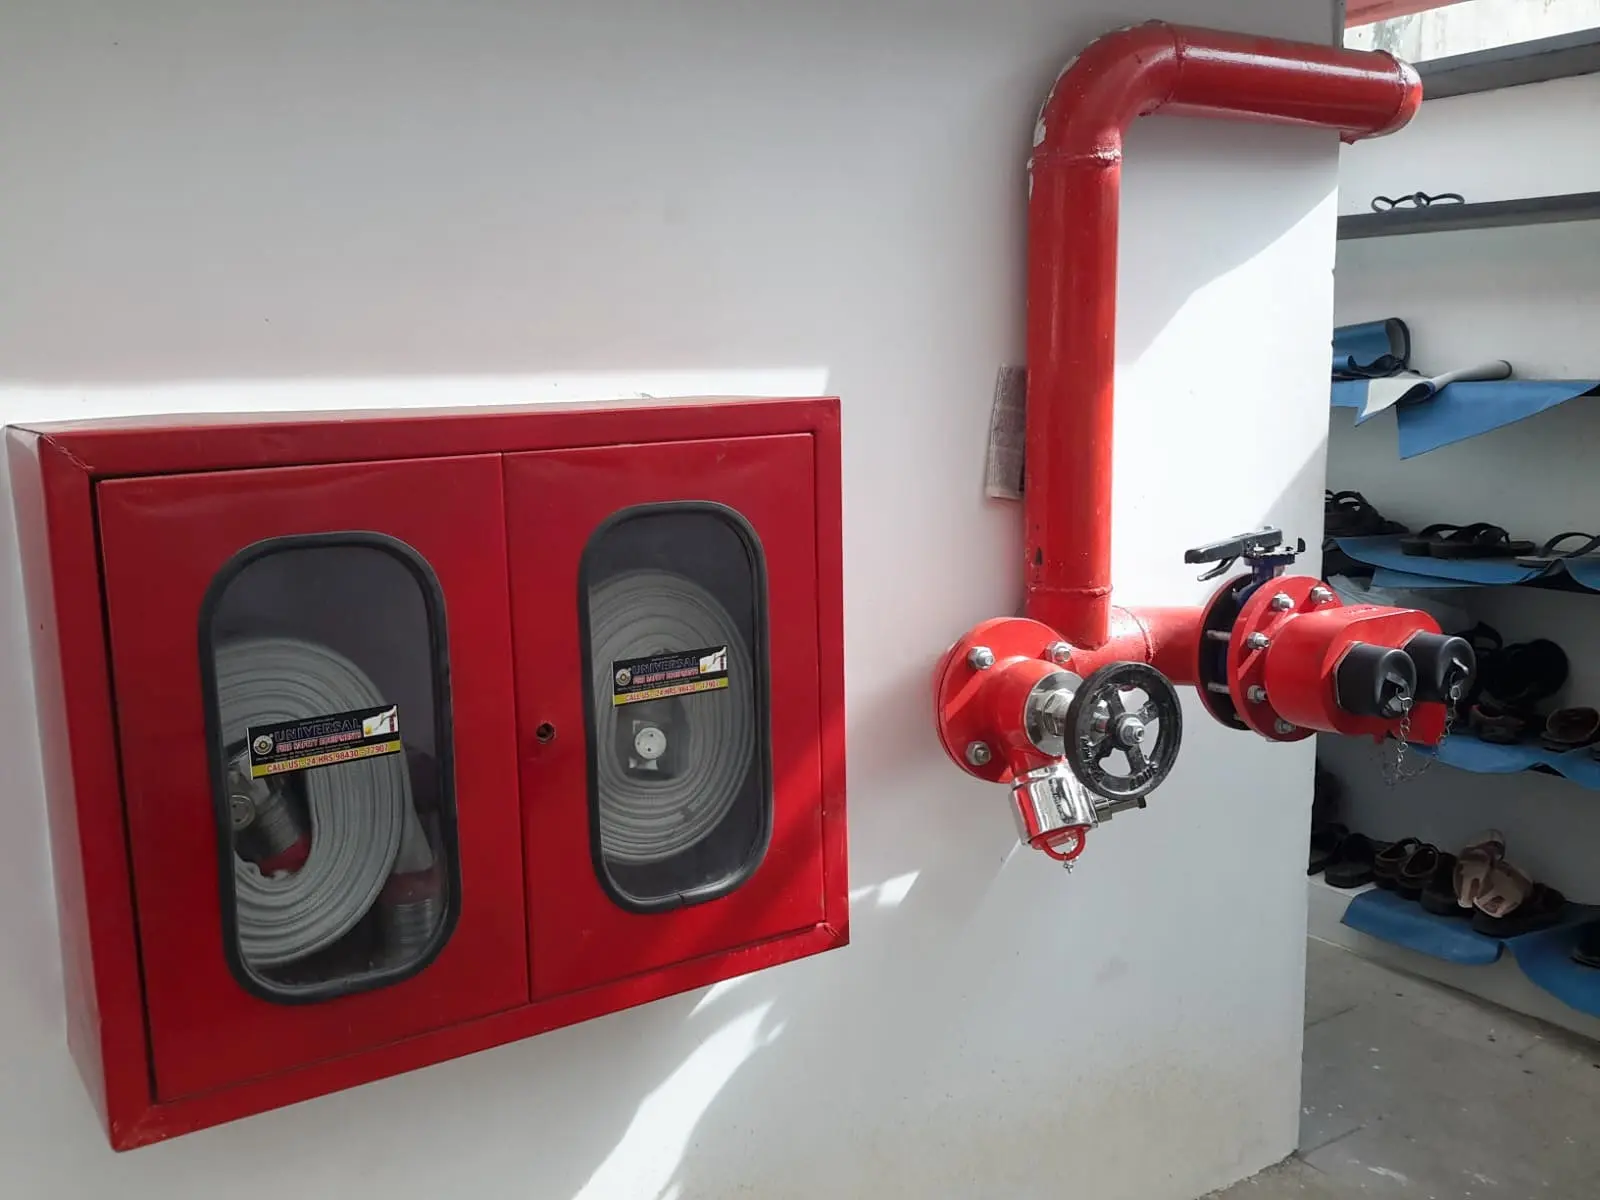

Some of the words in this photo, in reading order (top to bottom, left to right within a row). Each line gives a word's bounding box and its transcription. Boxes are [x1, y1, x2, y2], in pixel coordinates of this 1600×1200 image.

[631, 656, 700, 674] UNIVERSAL
[272, 718, 362, 742] UNIVERSAL
[266, 761, 285, 773] CALL
[287, 759, 299, 769] US
[306, 757, 316, 766] 24
[317, 752, 333, 764] HRS
[335, 748, 359, 761] 98430
